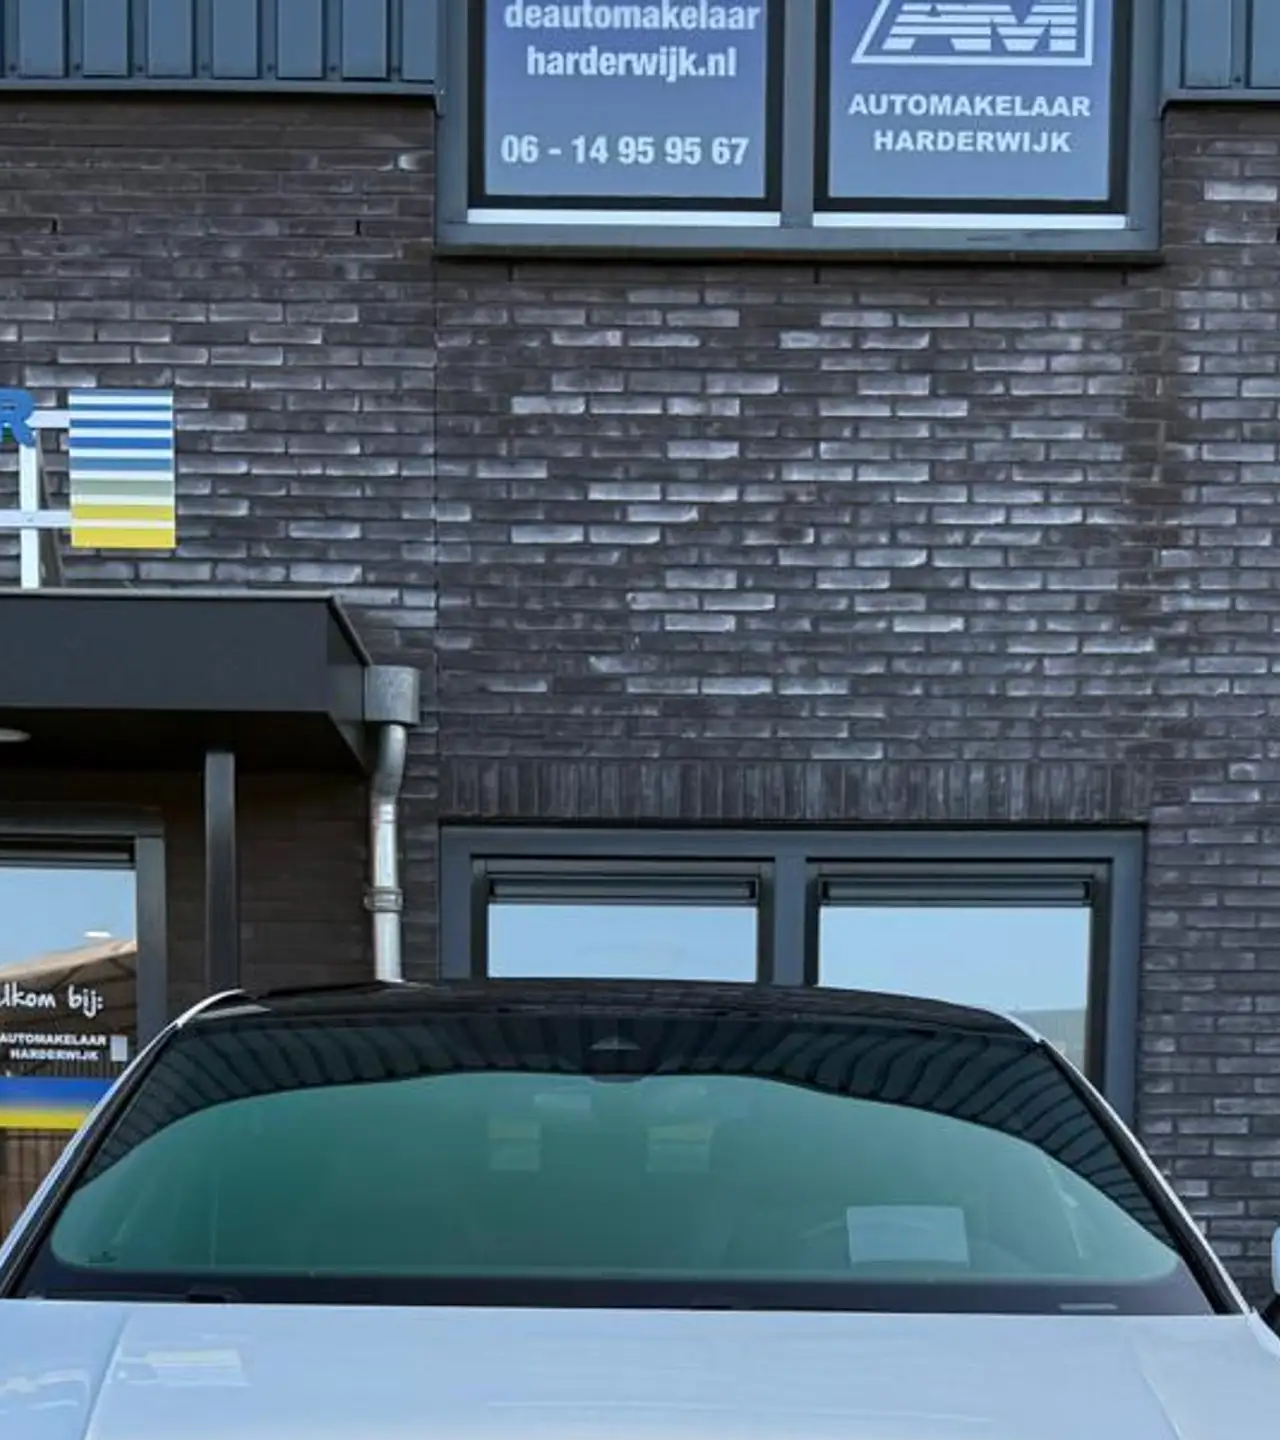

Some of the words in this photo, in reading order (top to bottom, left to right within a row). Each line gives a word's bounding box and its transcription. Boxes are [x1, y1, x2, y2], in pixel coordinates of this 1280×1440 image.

[504, 0, 760, 30] deautomakelaar
[526, 45, 737, 83] harderwijk.nl
[848, 94, 1092, 118] AUTOMAKELAAR
[500, 135, 538, 165] 06
[571, 136, 609, 165] 14
[617, 136, 656, 165] 95
[664, 137, 703, 165] 95
[711, 136, 749, 166] 67
[873, 128, 1072, 154] HARDERWIJK
[68, 984, 105, 1018] bij:
[0, 1033, 107, 1046] AUTOMAKELAAR
[9, 1048, 100, 1060] HARDERWIJK
